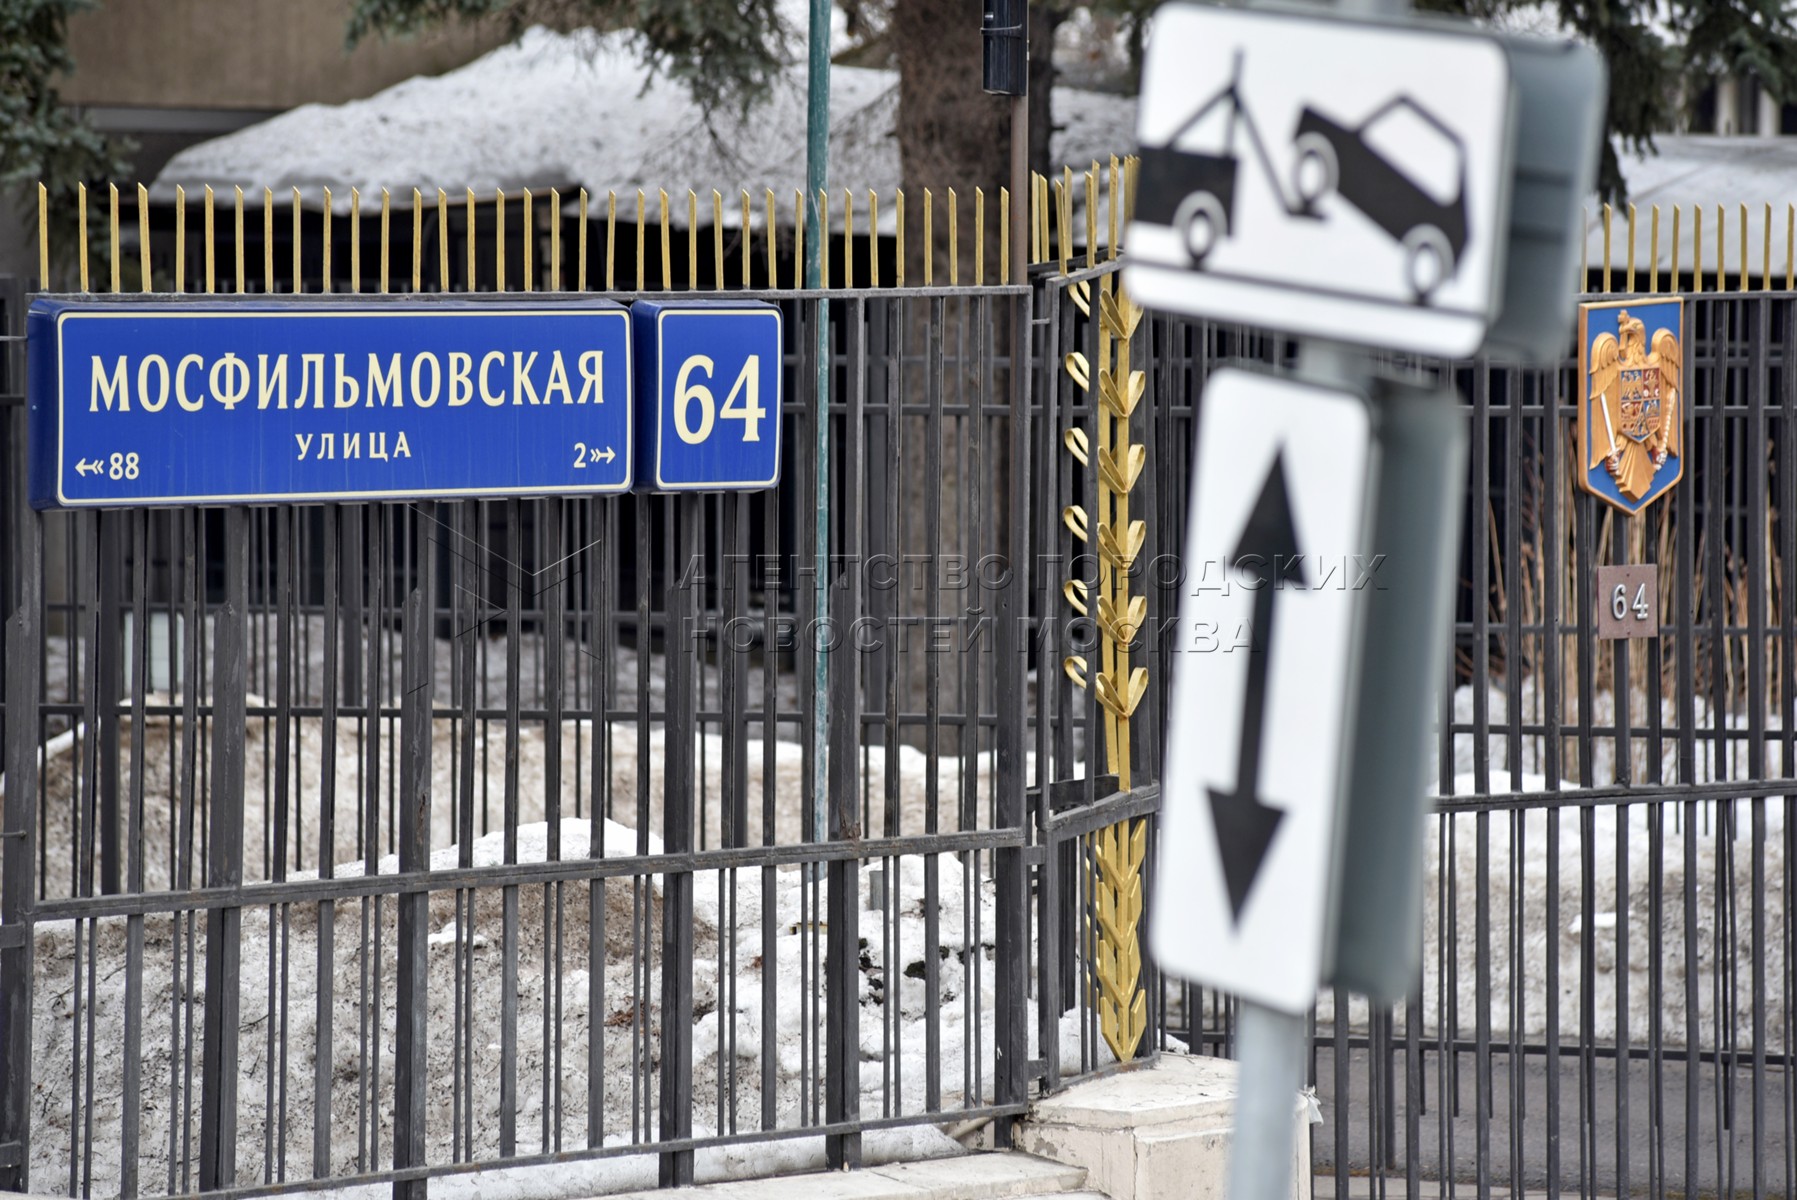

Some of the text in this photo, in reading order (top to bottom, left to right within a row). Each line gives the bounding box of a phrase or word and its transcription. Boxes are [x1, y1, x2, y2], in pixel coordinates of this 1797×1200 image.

[88, 349, 605, 412] МОСФИЛЬМОВСКАЯ
[672, 353, 767, 445] 64
[295, 431, 412, 462] УЛИЦА
[572, 442, 588, 469] 2
[109, 451, 140, 480] 88
[1611, 582, 1650, 621] 64
